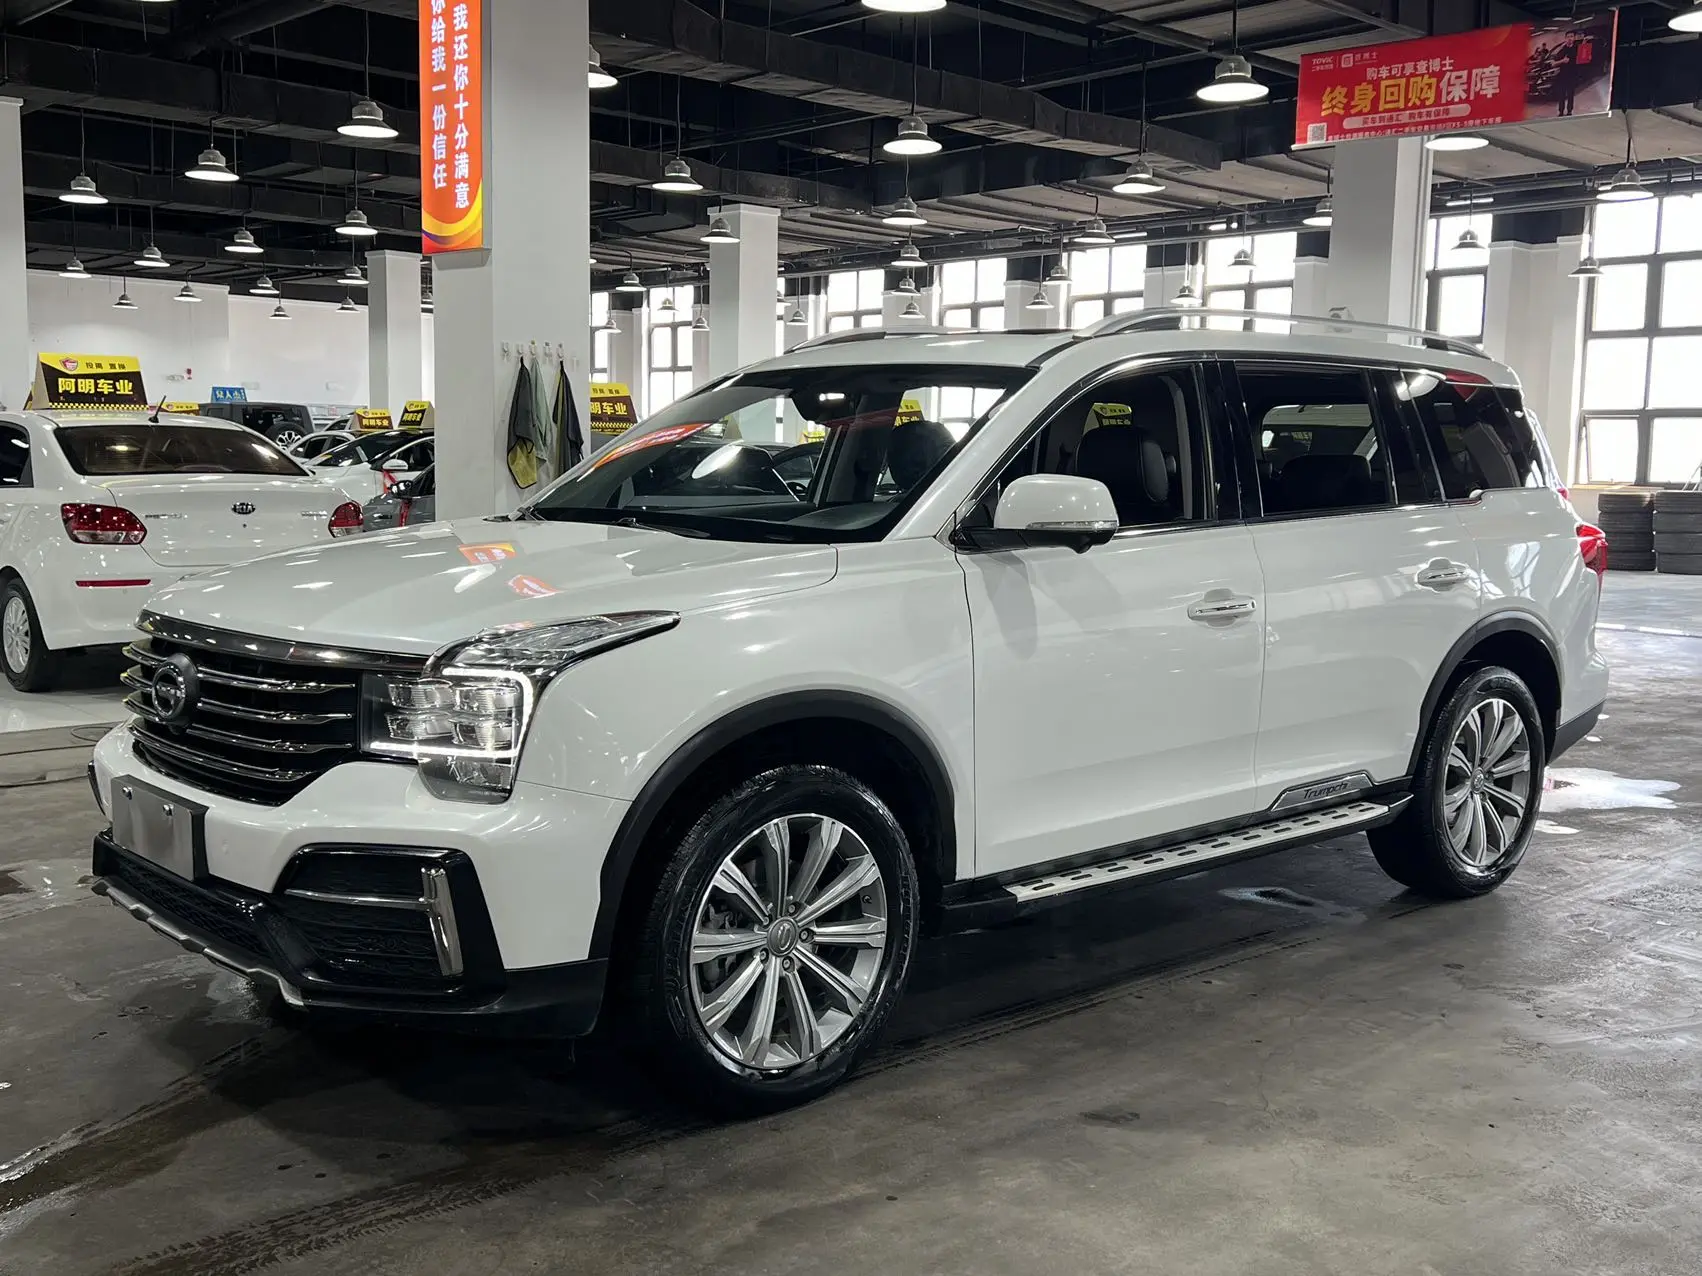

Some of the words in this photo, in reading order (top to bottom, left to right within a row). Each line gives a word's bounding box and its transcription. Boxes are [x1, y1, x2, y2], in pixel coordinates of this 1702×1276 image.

[1366, 56, 1454, 80] 购车可享查博士
[1320, 64, 1501, 117] 终身回购保障
[453, 3, 470, 209] 我还你十分满意
[57, 377, 134, 395] 阿明车业
[234, 502, 254, 514] KIA
